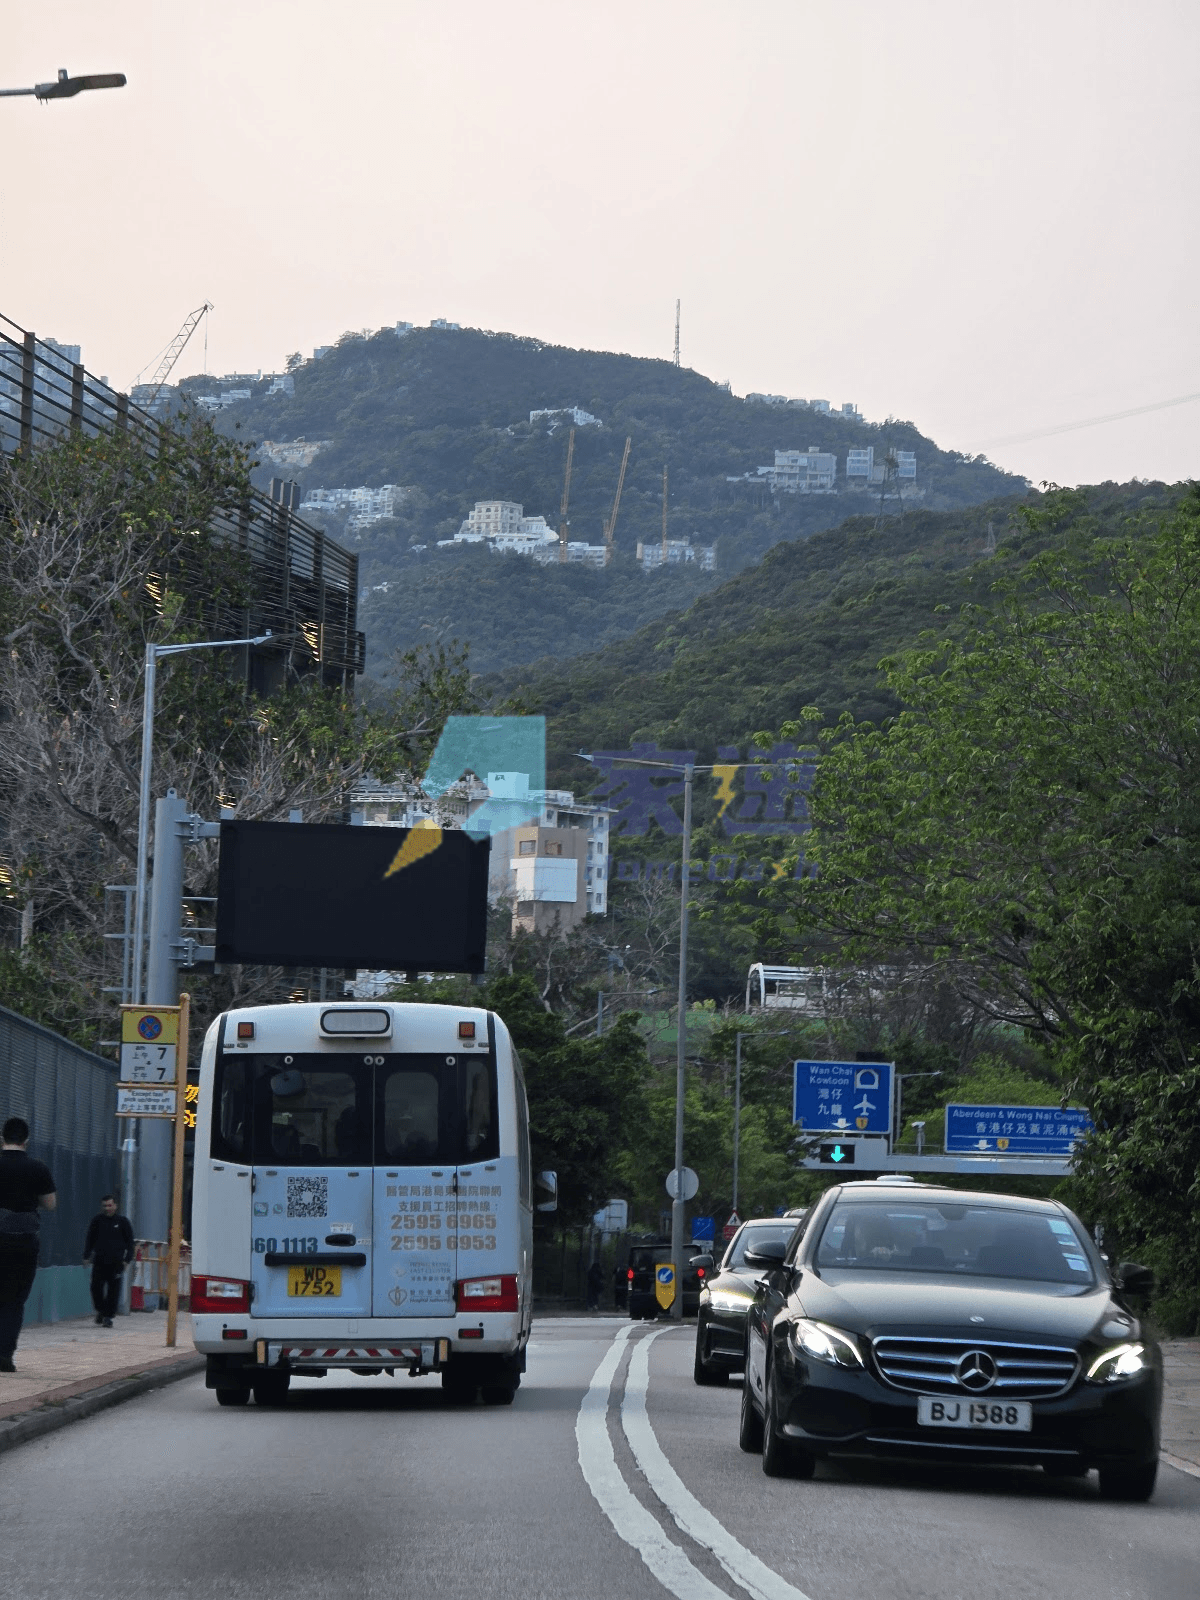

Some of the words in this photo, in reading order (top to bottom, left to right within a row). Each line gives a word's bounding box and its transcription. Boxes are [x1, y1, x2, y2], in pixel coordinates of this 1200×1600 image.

[157, 1047, 167, 1060] 7
[156, 1067, 166, 1080] 7
[809, 1066, 830, 1075] Wan
[832, 1066, 853, 1076] Chai
[809, 1076, 850, 1086] Kowloon
[817, 1103, 843, 1116] 九龍
[952, 1108, 996, 1119] Aberdeen
[998, 1110, 1005, 1119] &
[1006, 1110, 1033, 1121] Wong
[1035, 1111, 1052, 1121] Nai
[391, 1214, 442, 1230] 2595
[446, 1214, 497, 1230] 6965
[281, 1237, 319, 1253] 1113
[391, 1235, 442, 1251] 2595
[446, 1235, 497, 1251] 6953
[303, 1267, 327, 1281] WD
[294, 1281, 335, 1295] 1752
[931, 1402, 960, 1422] BJ
[969, 1404, 1018, 1425] 1388
